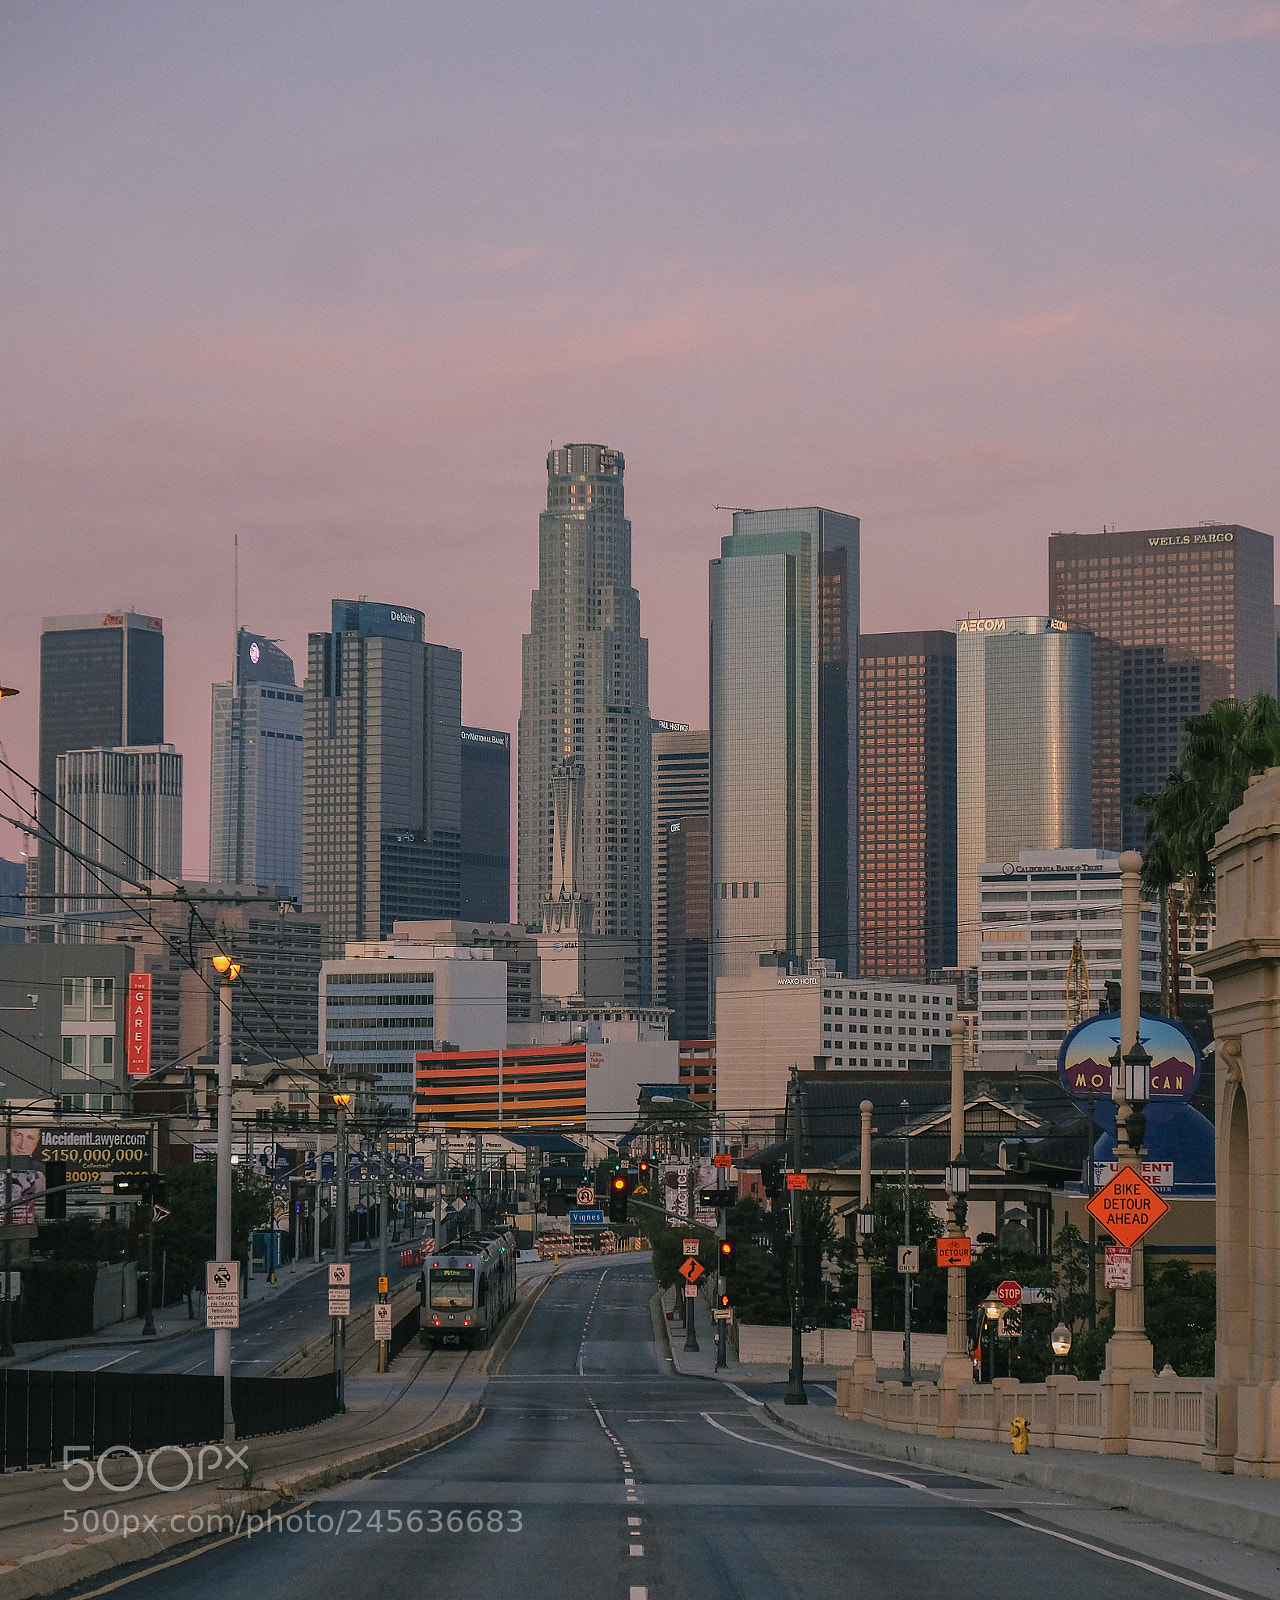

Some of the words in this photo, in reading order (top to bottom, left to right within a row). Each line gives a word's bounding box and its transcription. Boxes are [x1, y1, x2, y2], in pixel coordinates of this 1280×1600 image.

[1148, 535, 1191, 547] WELLS
[1193, 532, 1234, 544] FARGO
[390, 610, 416, 625] Deloitte
[959, 618, 1006, 633] AECOM
[1050, 618, 1068, 632] AECOM
[658, 720, 670, 730] PAUL
[1055, 865, 1076, 873] BANK
[1081, 863, 1104, 872] TRUST
[800, 976, 818, 986] HOTEL
[134, 992, 145, 1055] GAREY
[1075, 1073, 1183, 1090] MOCAN
[1109, 1163, 1172, 1173] UENT
[1113, 1183, 1141, 1196] BIKE
[1103, 1198, 1151, 1210] DETOUR
[572, 1212, 601, 1223] Vignes
[1106, 1213, 1149, 1225] AHEAD
[685, 1246, 697, 1254] 25
[939, 1249, 969, 1257] DETOUR
[999, 1288, 1021, 1299] STOP
